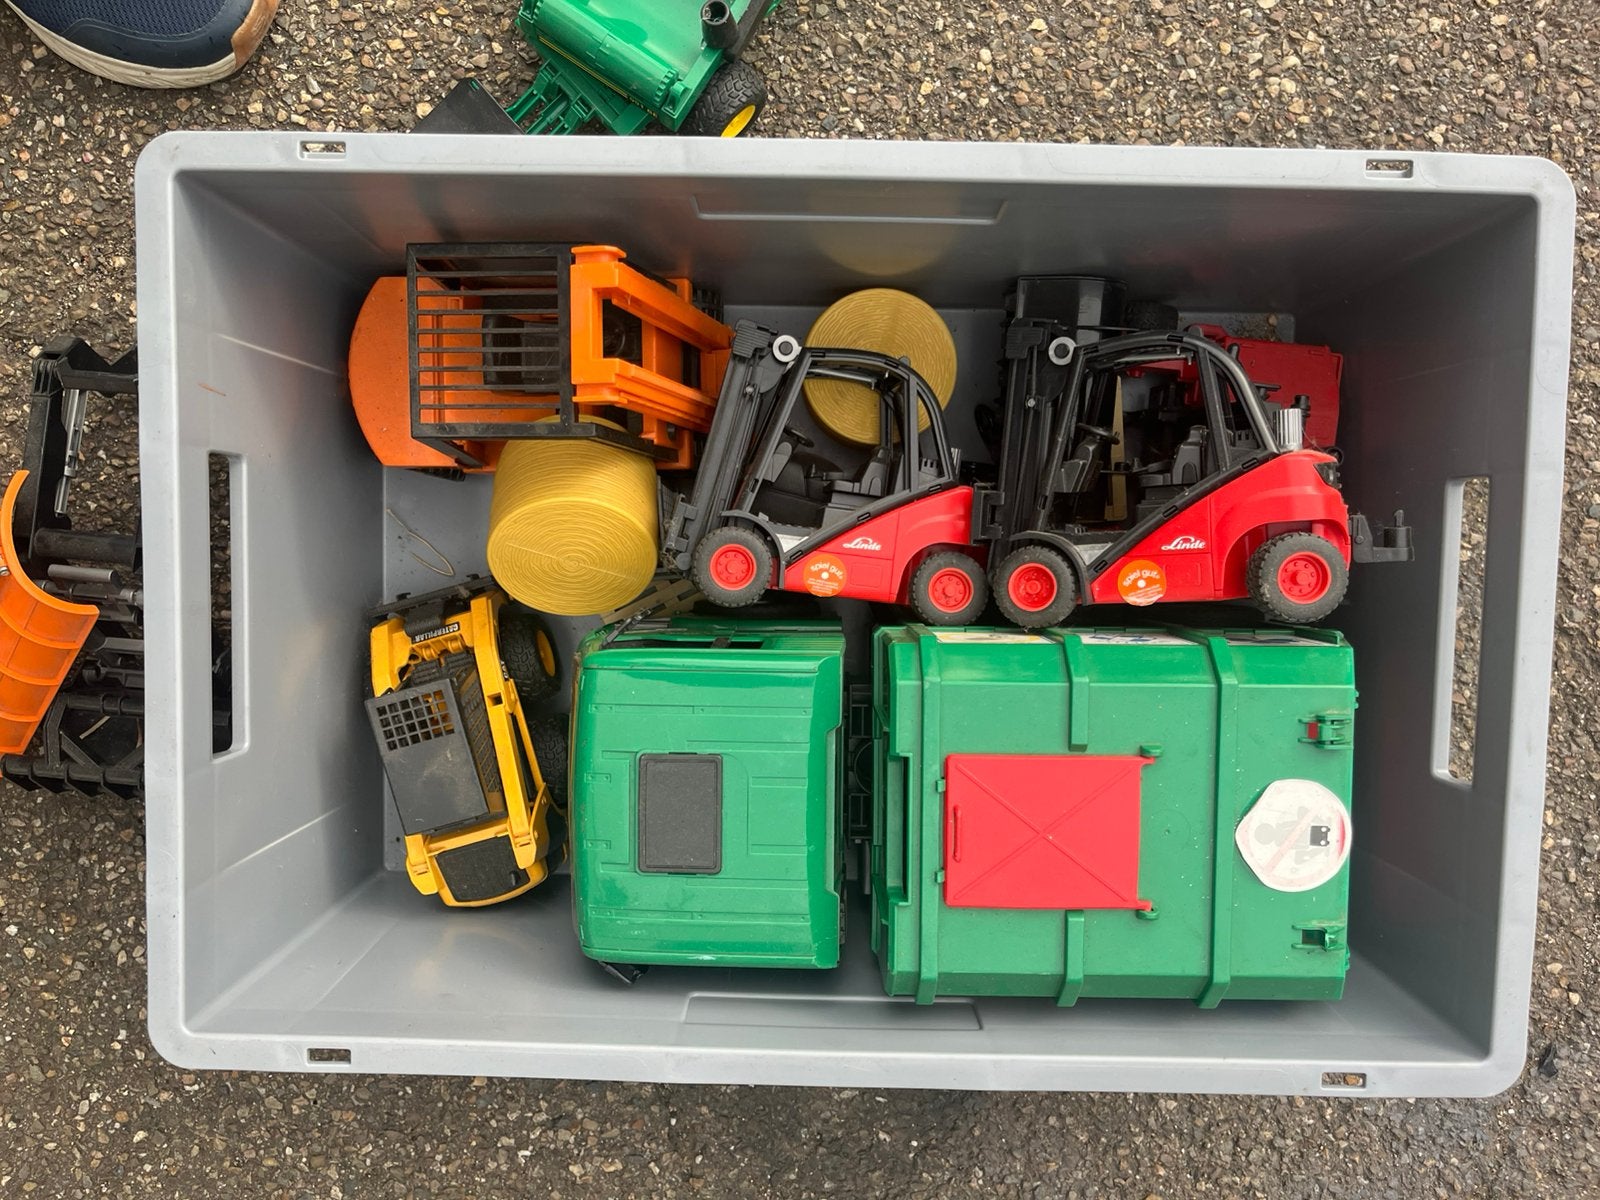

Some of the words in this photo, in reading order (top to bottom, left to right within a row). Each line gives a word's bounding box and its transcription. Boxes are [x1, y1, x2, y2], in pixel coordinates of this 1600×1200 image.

[842, 536, 882, 551] Linde
[1161, 535, 1206, 551] Linde
[414, 623, 459, 642] CATERPILLAR
